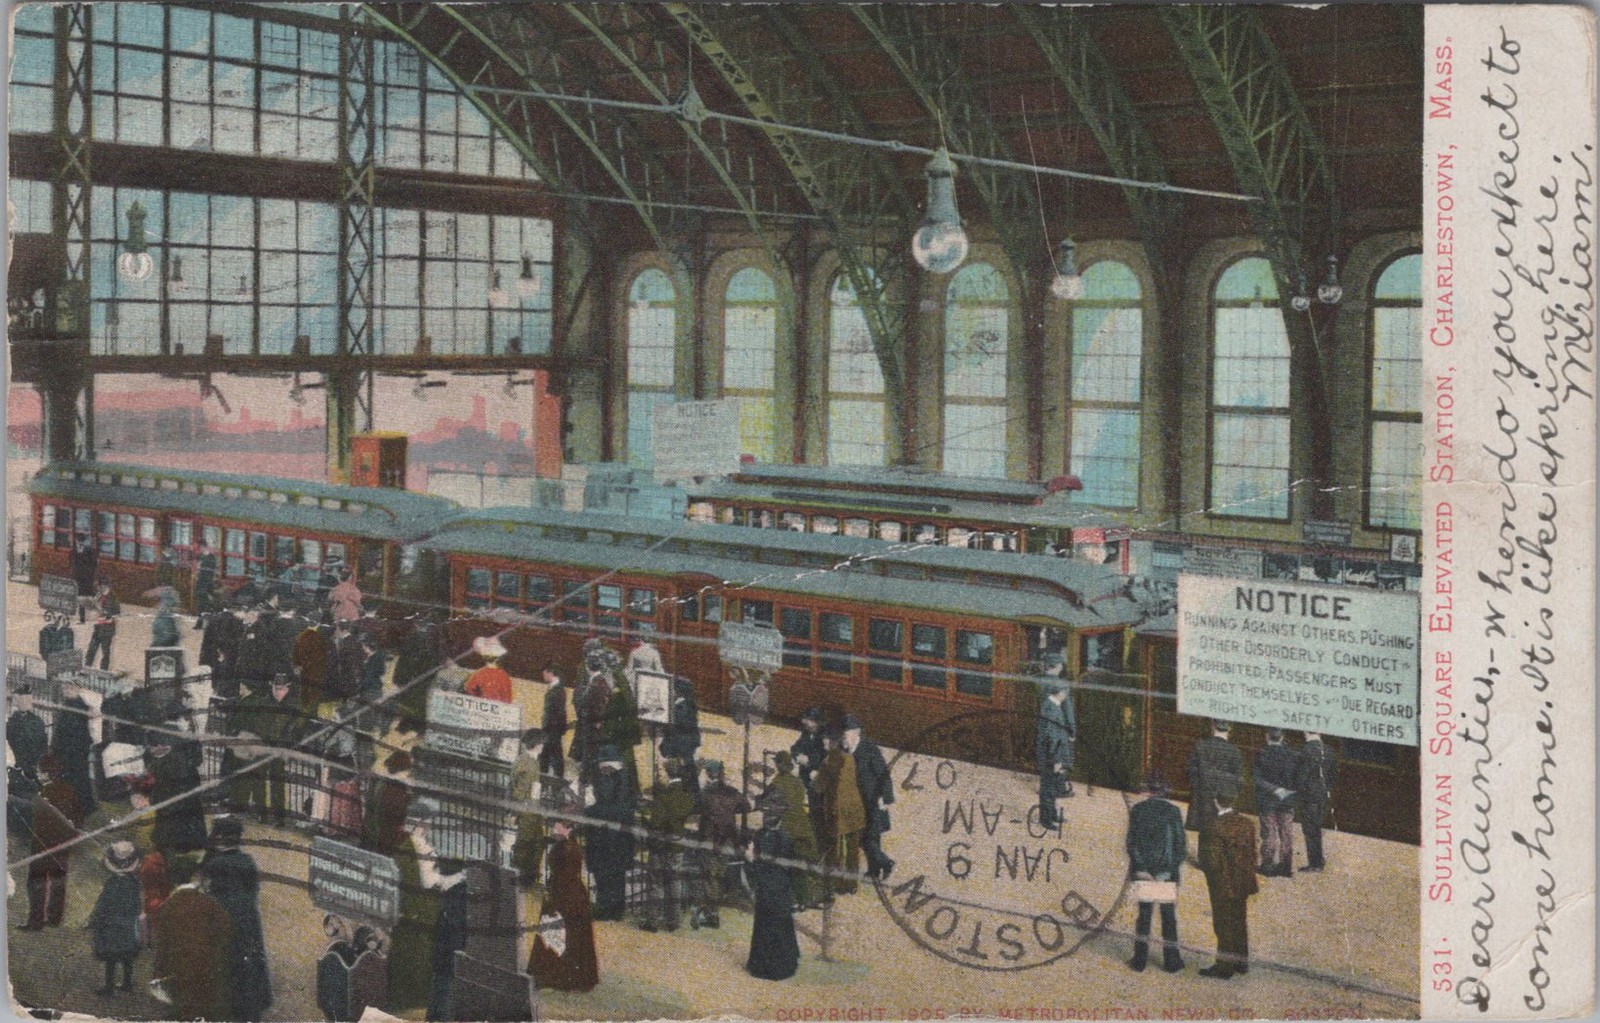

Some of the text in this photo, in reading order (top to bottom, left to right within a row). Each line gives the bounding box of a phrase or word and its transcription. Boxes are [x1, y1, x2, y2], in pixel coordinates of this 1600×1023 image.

[1429, 36, 1453, 120] MASS.
[1481, 26, 1521, 77] to
[1479, 84, 1520, 268] expect
[1430, 143, 1457, 348] CHARLESTOWN,
[1490, 274, 1537, 393] you
[1430, 365, 1457, 484] STATION,
[1483, 398, 1520, 483] do
[1429, 501, 1453, 634] ELEVATED
[1515, 491, 1557, 593] like
[1183, 610, 1238, 630] RUNNING
[1241, 617, 1296, 637] AGAINST
[1360, 630, 1415, 650] PUSHING
[1235, 587, 1351, 621] NOTICE
[1533, 608, 1555, 642] is
[1199, 635, 1239, 653] OTHER
[1244, 639, 1325, 663] DISORDERLY
[1333, 650, 1399, 671] CONDUCT
[1268, 664, 1358, 690] PASSENGERS
[1364, 677, 1402, 695] MUST
[444, 695, 500, 716] NOTICE
[1182, 675, 1236, 695] CONDUCT
[1241, 683, 1320, 707] THEMSELVES
[1342, 695, 1362, 712] DUE
[1365, 697, 1414, 719] REGARD
[1209, 698, 1257, 718] RIGHTS
[1281, 709, 1332, 727] SAFETY
[1352, 718, 1405, 739] OTHERS
[1429, 651, 1455, 756] SQUARE
[945, 842, 1069, 882] JAN 9
[1429, 774, 1453, 904] SULLIVAN
[891, 875, 1101, 961] BOSTON
[1457, 880, 1497, 1014] Dear
[1521, 870, 1556, 1012] come
[776, 1008, 885, 1021] COPYRIGHT
[999, 1008, 1149, 1020] METROPOLITAN
